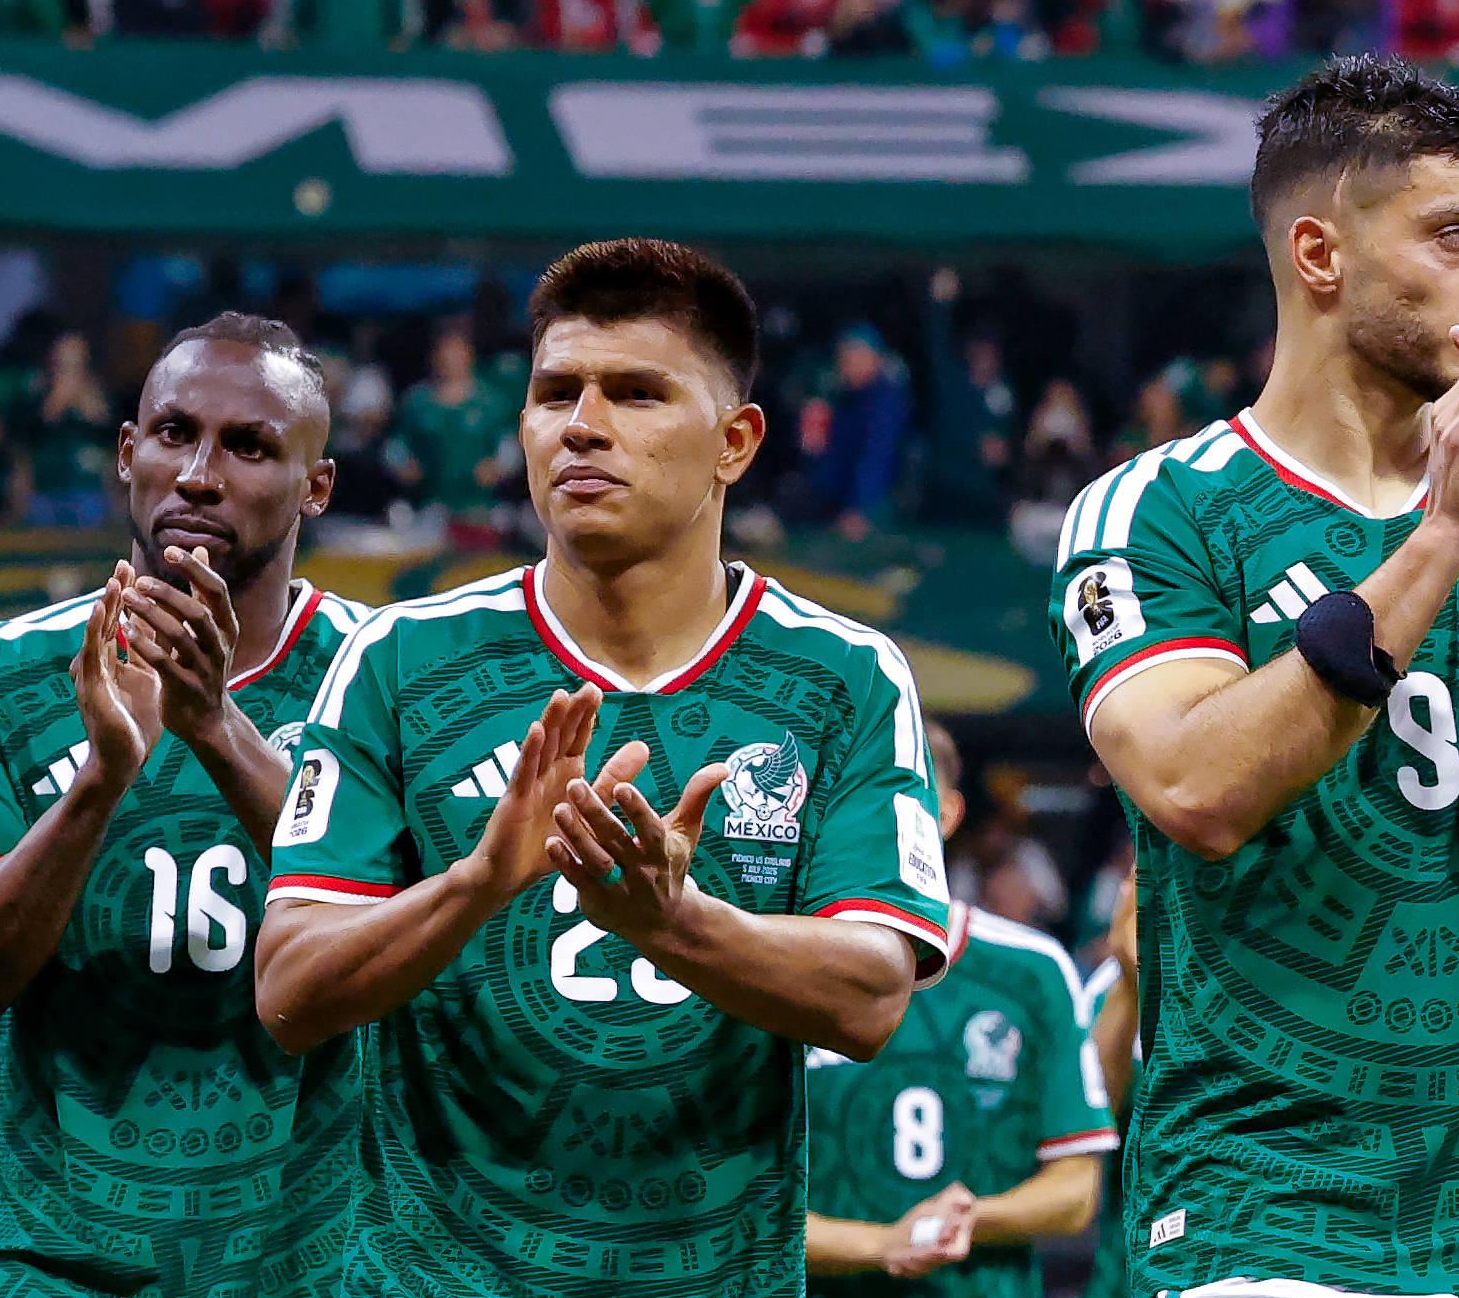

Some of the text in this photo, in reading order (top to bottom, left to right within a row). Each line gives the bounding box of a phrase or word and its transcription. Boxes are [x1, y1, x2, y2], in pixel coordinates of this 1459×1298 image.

[726, 818, 797, 840] MÉXICO
[144, 844, 248, 974] 16
[893, 1086, 944, 1180] 8
